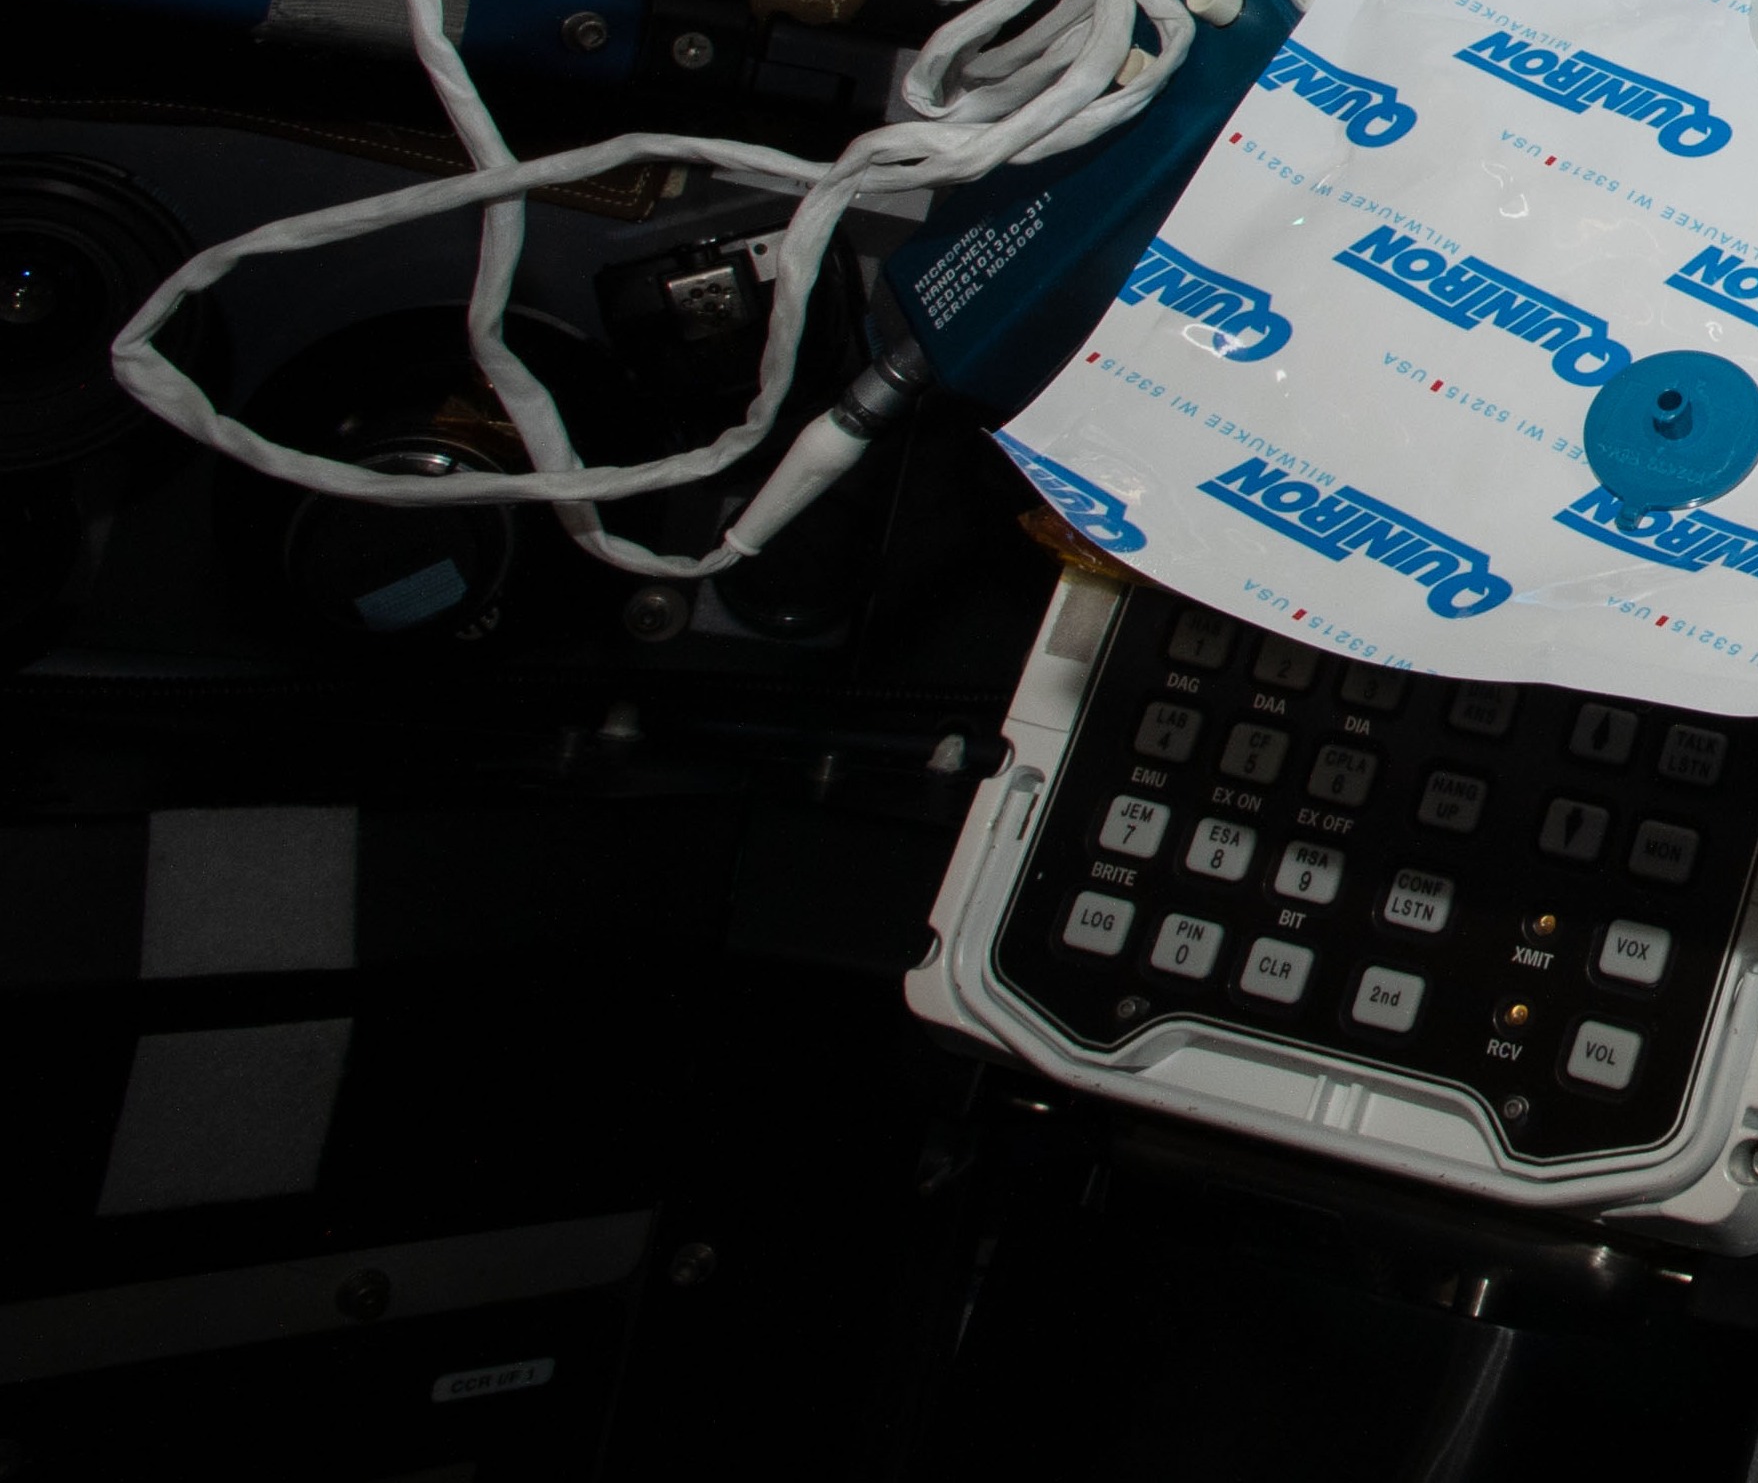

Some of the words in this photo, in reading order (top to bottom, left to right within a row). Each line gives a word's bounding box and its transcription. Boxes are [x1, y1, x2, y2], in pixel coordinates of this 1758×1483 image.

[1498, 129, 1542, 157] USA
[1242, 139, 1305, 187] 53215
[1559, 159, 1620, 192] 53215
[1625, 188, 1653, 210] WI
[1337, 190, 1460, 256] MILWAUKEE
[920, 228, 996, 306] HAND-HELD
[934, 282, 984, 331] SERIAL
[1100, 357, 1166, 399] 53215
[1383, 352, 1428, 383] USA
[1169, 394, 1200, 418] WI
[1444, 385, 1512, 424] 53215
[1516, 419, 1545, 443] WI
[1203, 412, 1336, 487] MILWAUKEE
[1243, 578, 1291, 612] USA
[1606, 595, 1652, 620] USA
[1307, 616, 1378, 659] 53215
[1671, 619, 1744, 657] 53215
[1277, 660, 1289, 679] 2
[1167, 672, 1201, 694] DAG
[1365, 678, 1378, 701] 3
[1253, 693, 1288, 715] DAA
[1156, 707, 1189, 730] LAB
[1344, 715, 1370, 737] DIA
[1157, 732, 1172, 750] 4
[1249, 732, 1271, 749] CF
[1676, 729, 1718, 753] TALK
[1244, 754, 1257, 774] 5
[1326, 749, 1367, 774] CPLA
[1667, 753, 1711, 777] LSTN
[1131, 766, 1168, 789] EMU
[1332, 775, 1344, 795] 6
[1432, 777, 1478, 801] HANG
[1212, 787, 1234, 805] EX
[1236, 793, 1263, 813] ON
[1437, 802, 1458, 818] UP
[1120, 803, 1154, 824] JEM
[1297, 807, 1321, 826] EX
[1323, 813, 1354, 835] OFF
[1122, 825, 1136, 845] 7
[1209, 826, 1241, 847] ESA
[1211, 849, 1224, 870] 8
[1295, 848, 1329, 870] RSA
[1091, 861, 1138, 887] BRITE
[1300, 872, 1312, 892] 9
[1397, 873, 1444, 897] CONF
[1081, 909, 1115, 931] LOG
[1278, 909, 1305, 930] BIT
[1392, 895, 1434, 921] LSTN
[1177, 920, 1204, 941] PIN
[1175, 944, 1189, 965] 0
[1511, 945, 1555, 970] XMIT
[1617, 937, 1651, 961] VOX
[1259, 955, 1292, 980] CLR
[1369, 985, 1401, 1007] 2nd
[1487, 1039, 1523, 1062] RCV
[1584, 1040, 1616, 1066] VOL
